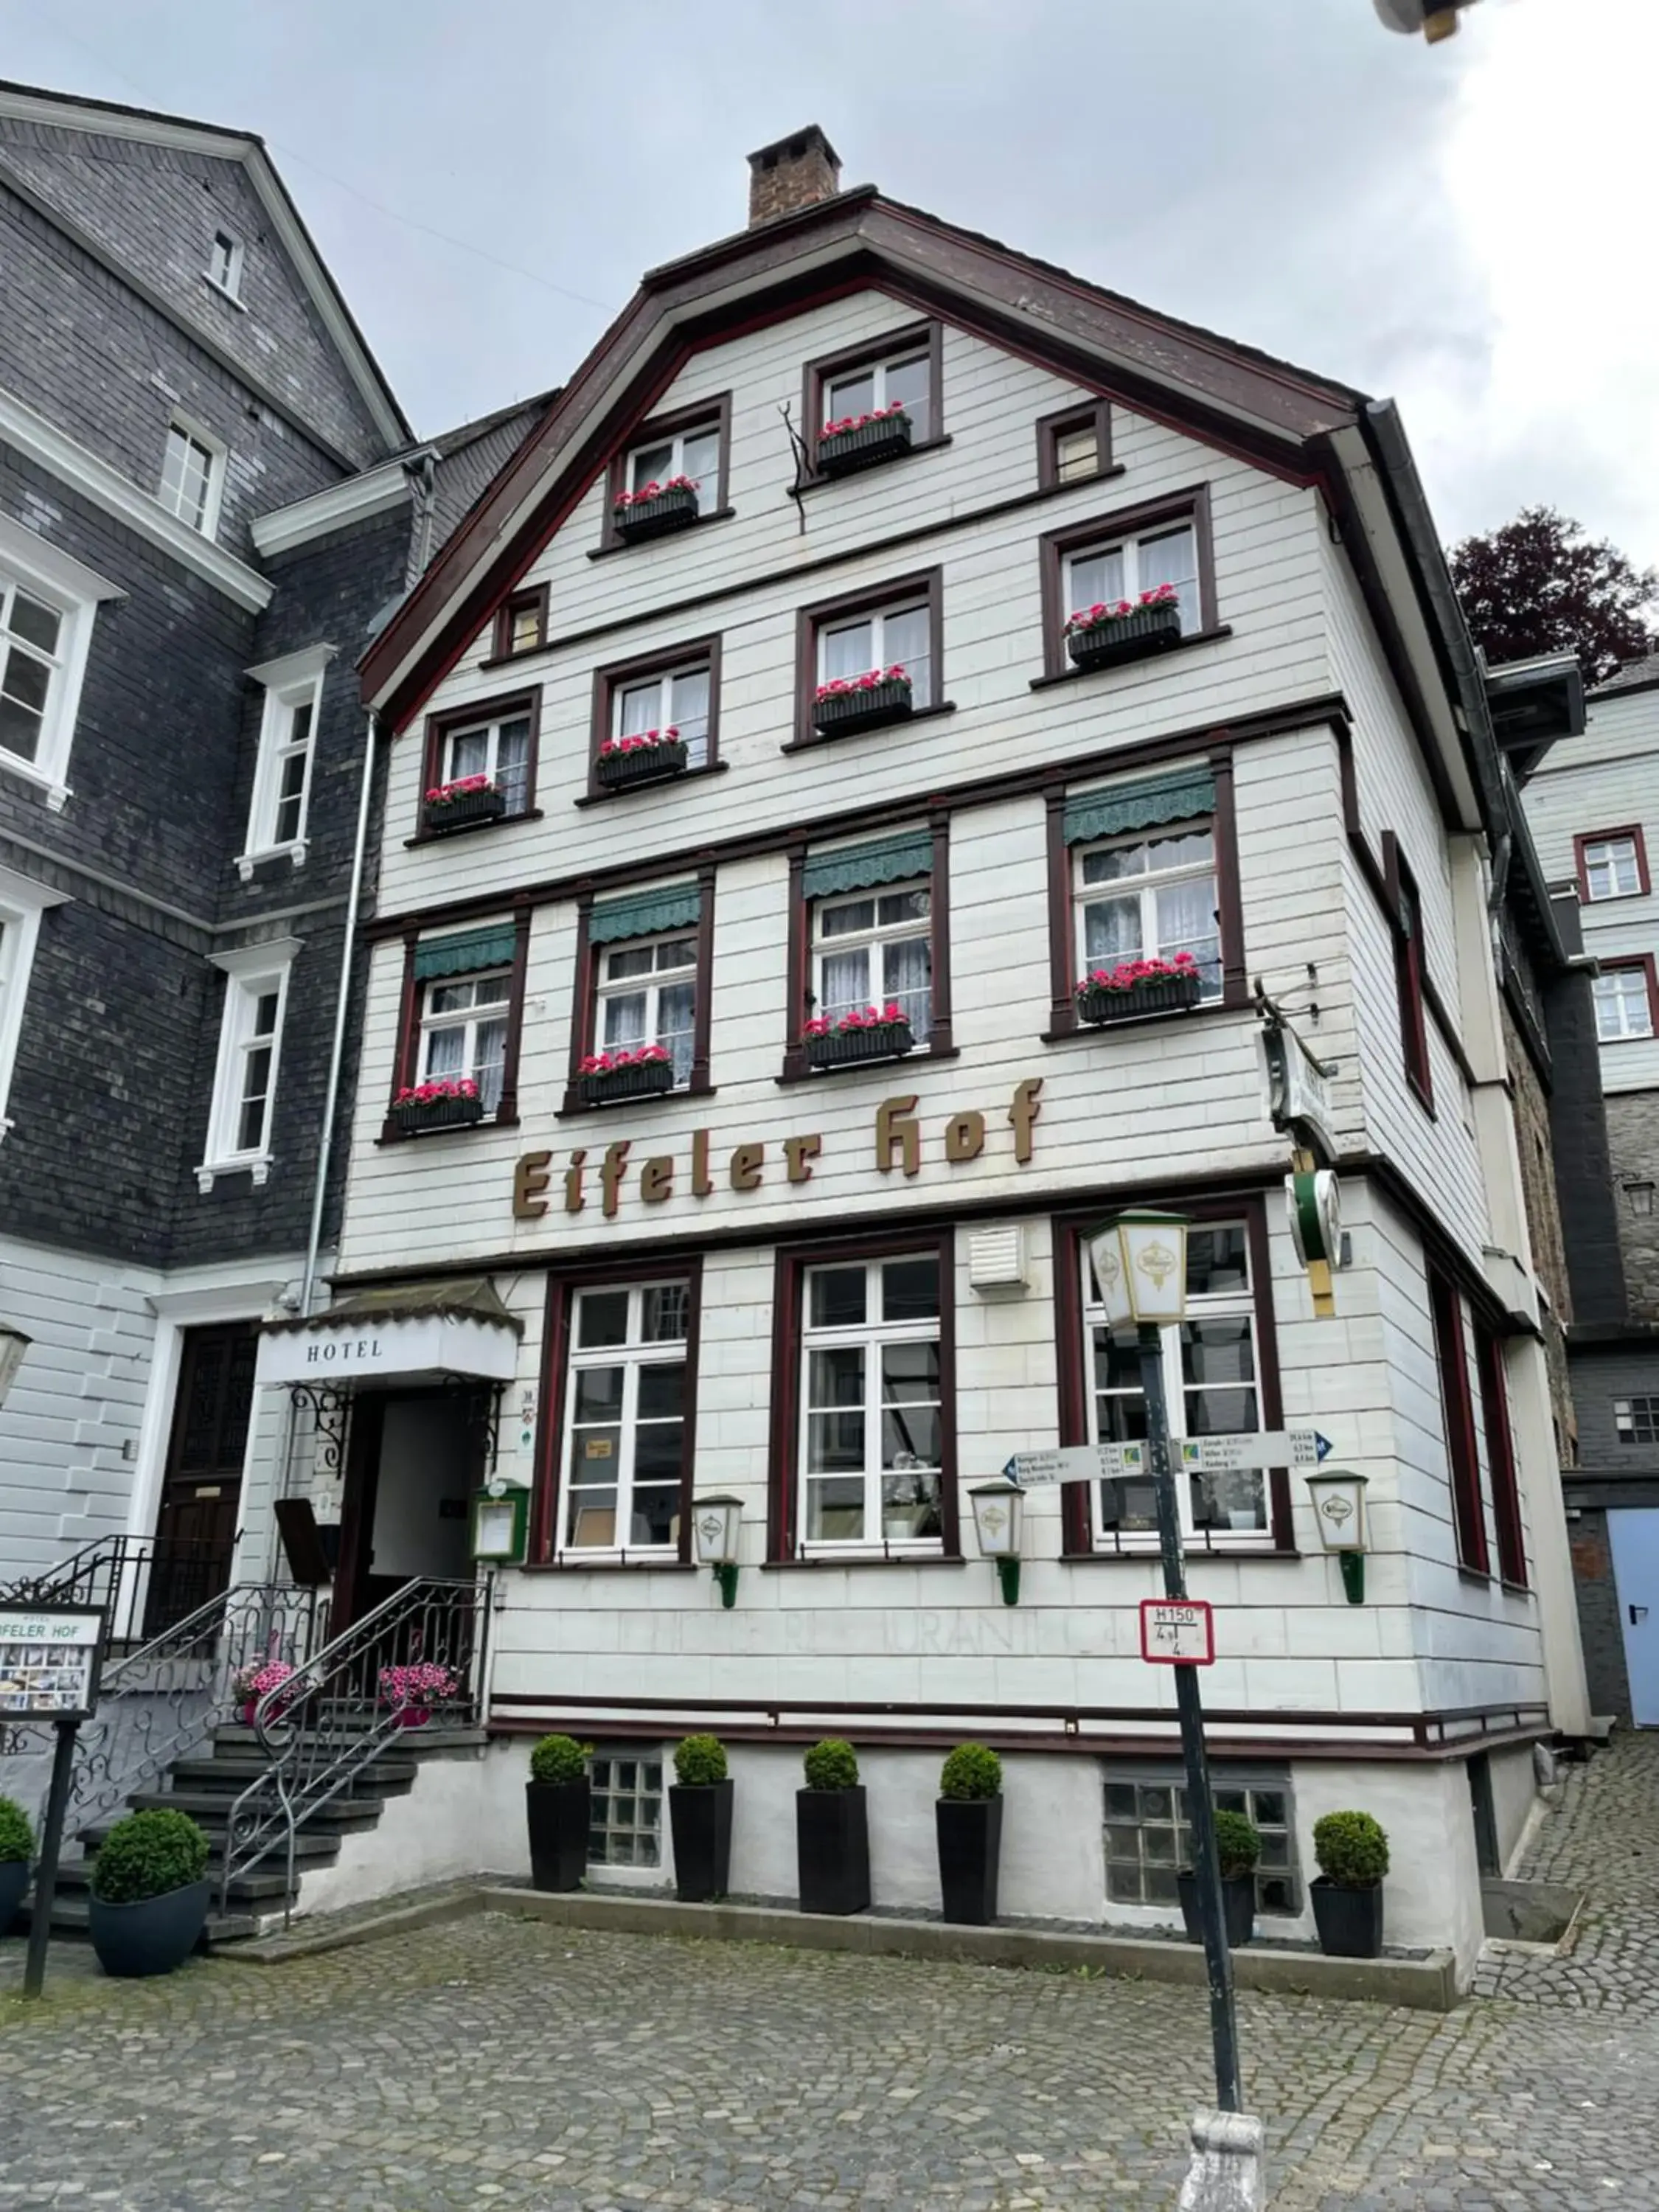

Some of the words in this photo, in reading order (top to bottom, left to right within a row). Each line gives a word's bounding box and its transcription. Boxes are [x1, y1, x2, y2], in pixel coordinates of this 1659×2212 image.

[512, 1128, 821, 1218] Eifeler
[307, 1340, 383, 1363] HOTEL
[1155, 1607, 1194, 1622] H150
[52, 1624, 80, 1638] HOF
